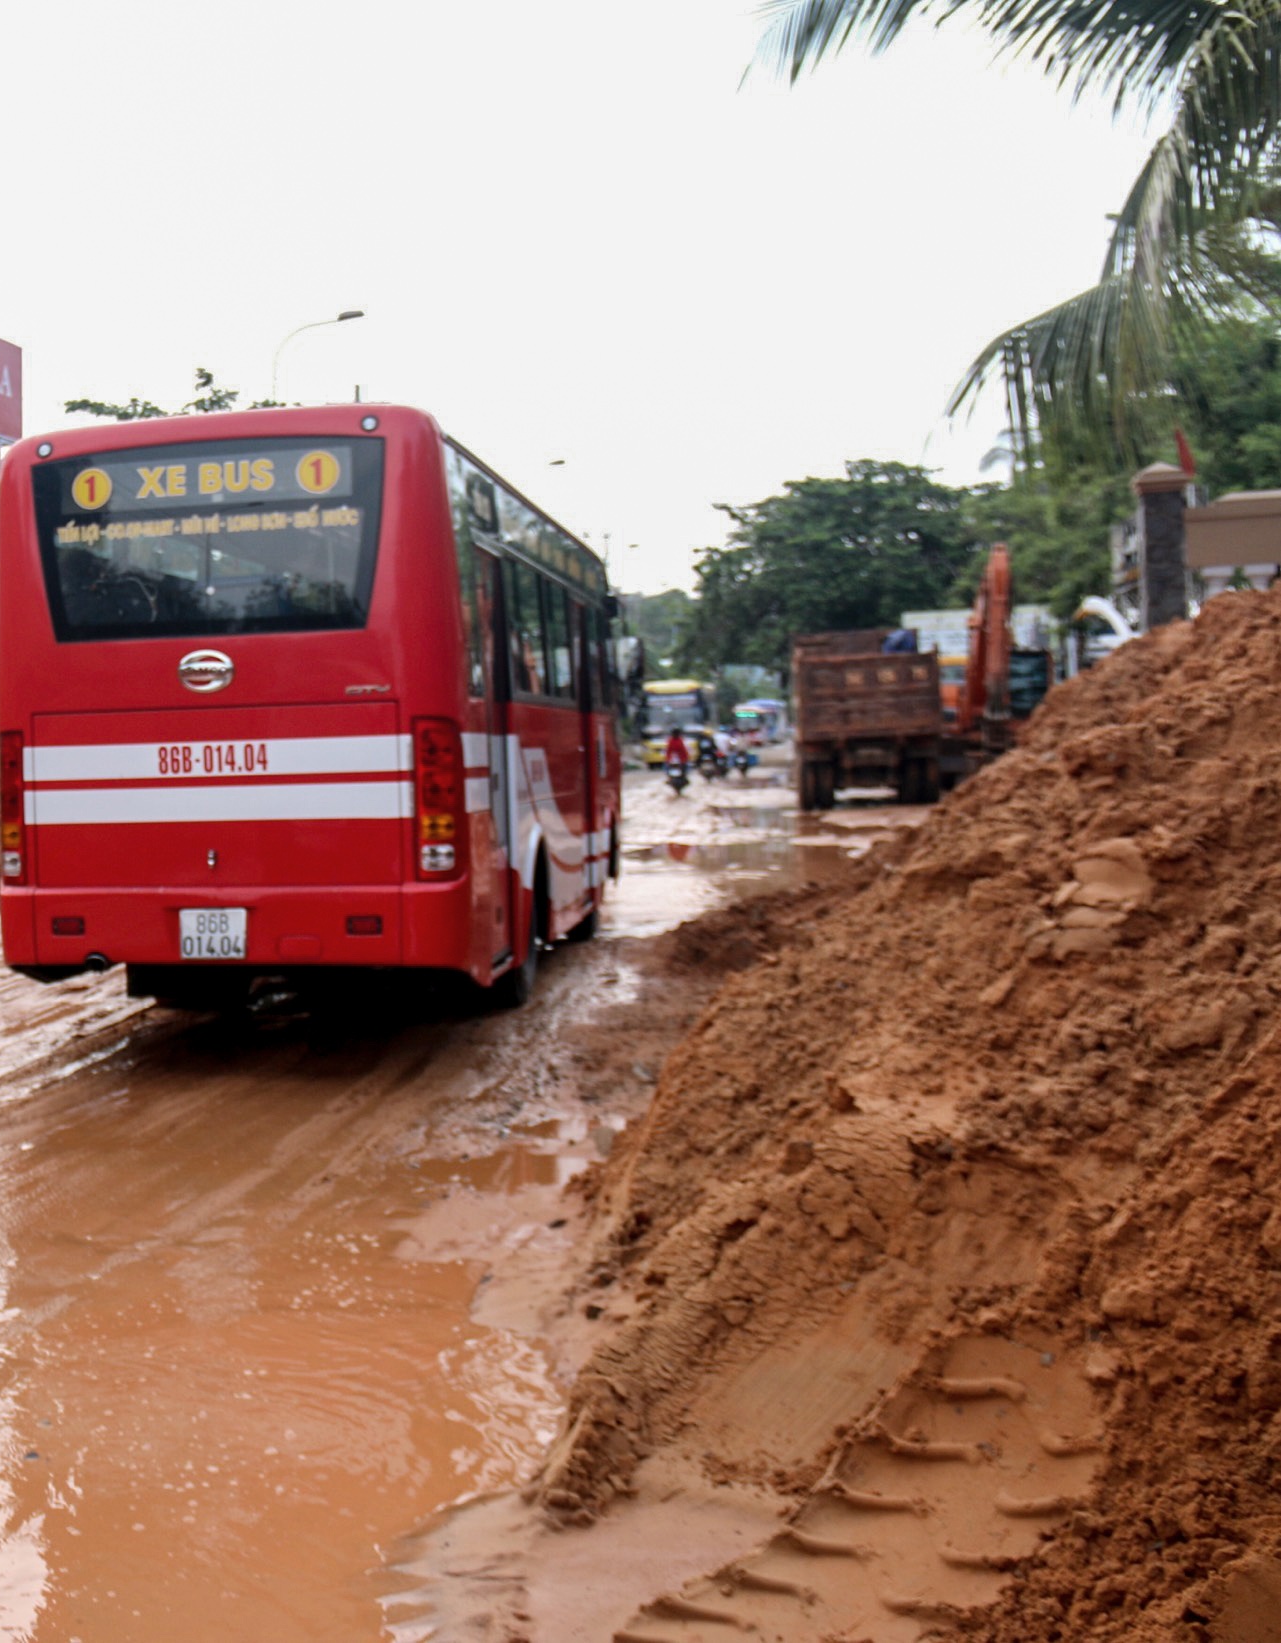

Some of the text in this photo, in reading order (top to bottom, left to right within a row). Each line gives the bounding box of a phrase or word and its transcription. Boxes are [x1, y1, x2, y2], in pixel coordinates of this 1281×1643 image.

[136, 465, 187, 499] XE
[199, 459, 276, 494] BUS
[158, 743, 268, 775] 86B-014.04
[196, 913, 229, 934] 86B
[182, 935, 243, 957] 014.04
